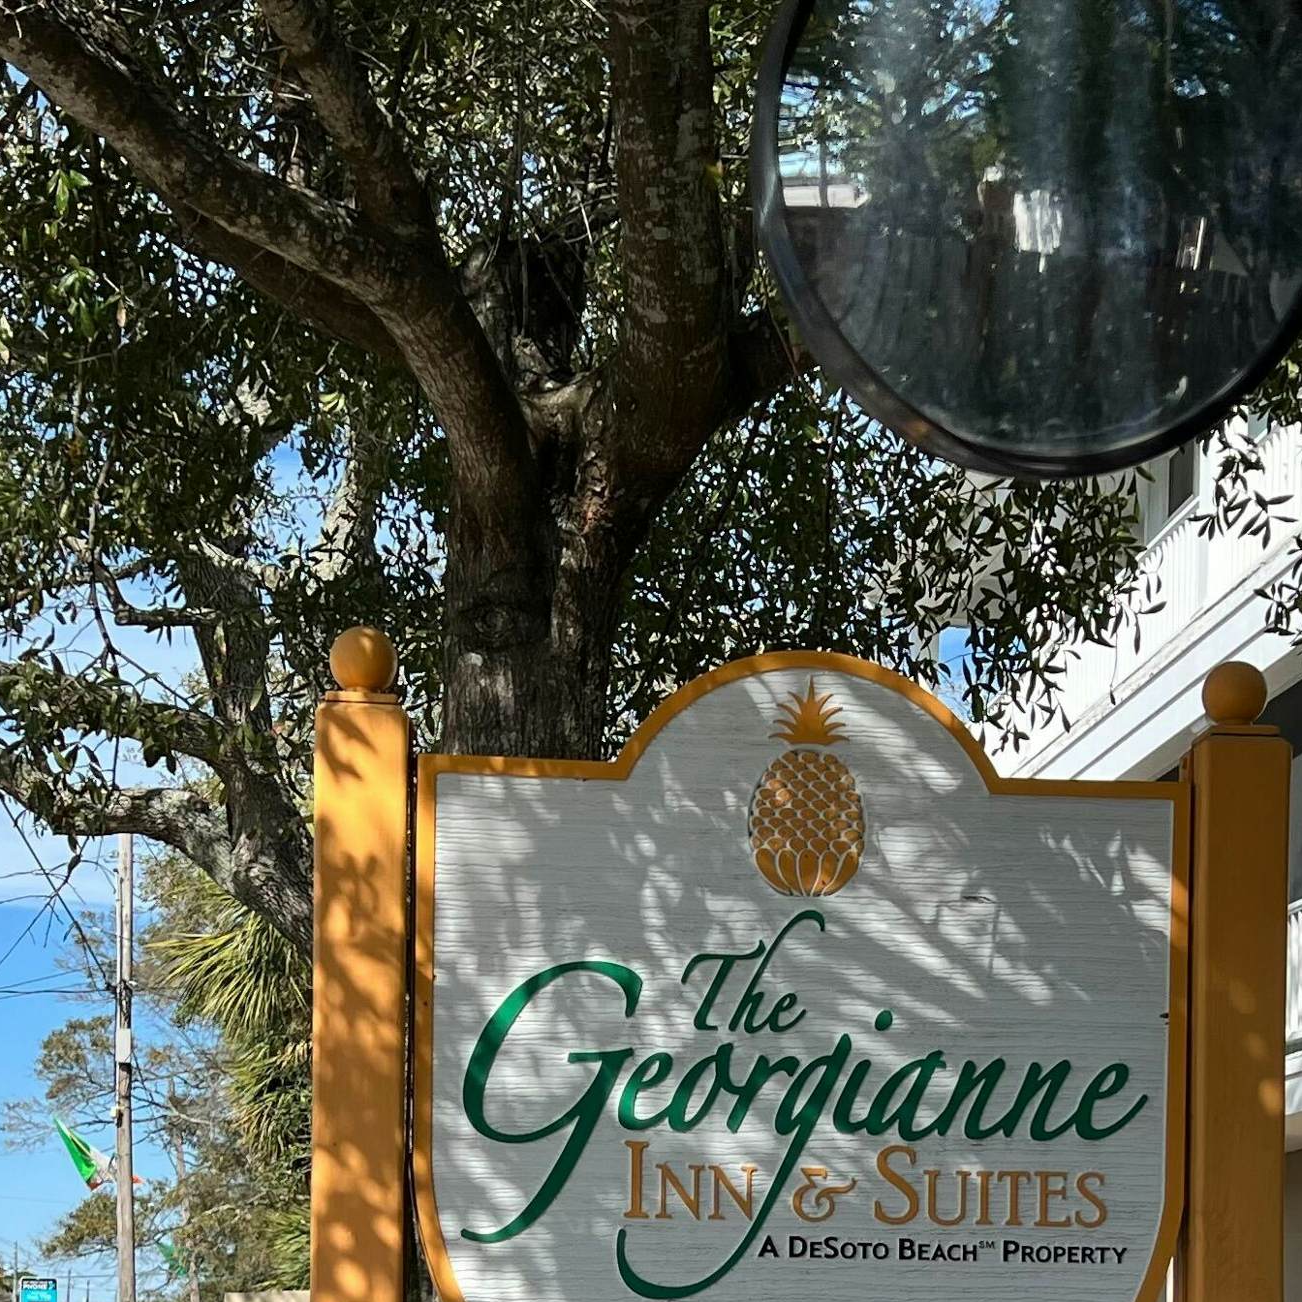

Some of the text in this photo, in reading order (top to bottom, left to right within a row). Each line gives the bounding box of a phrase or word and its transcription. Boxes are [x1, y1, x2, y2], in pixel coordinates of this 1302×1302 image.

[681, 909, 826, 1035] The
[460, 959, 1149, 1300] Georgianne
[623, 1139, 1109, 1229] INN & SUITES
[757, 1235, 779, 1258] A
[1002, 1240, 1128, 1265] PROPERTY
